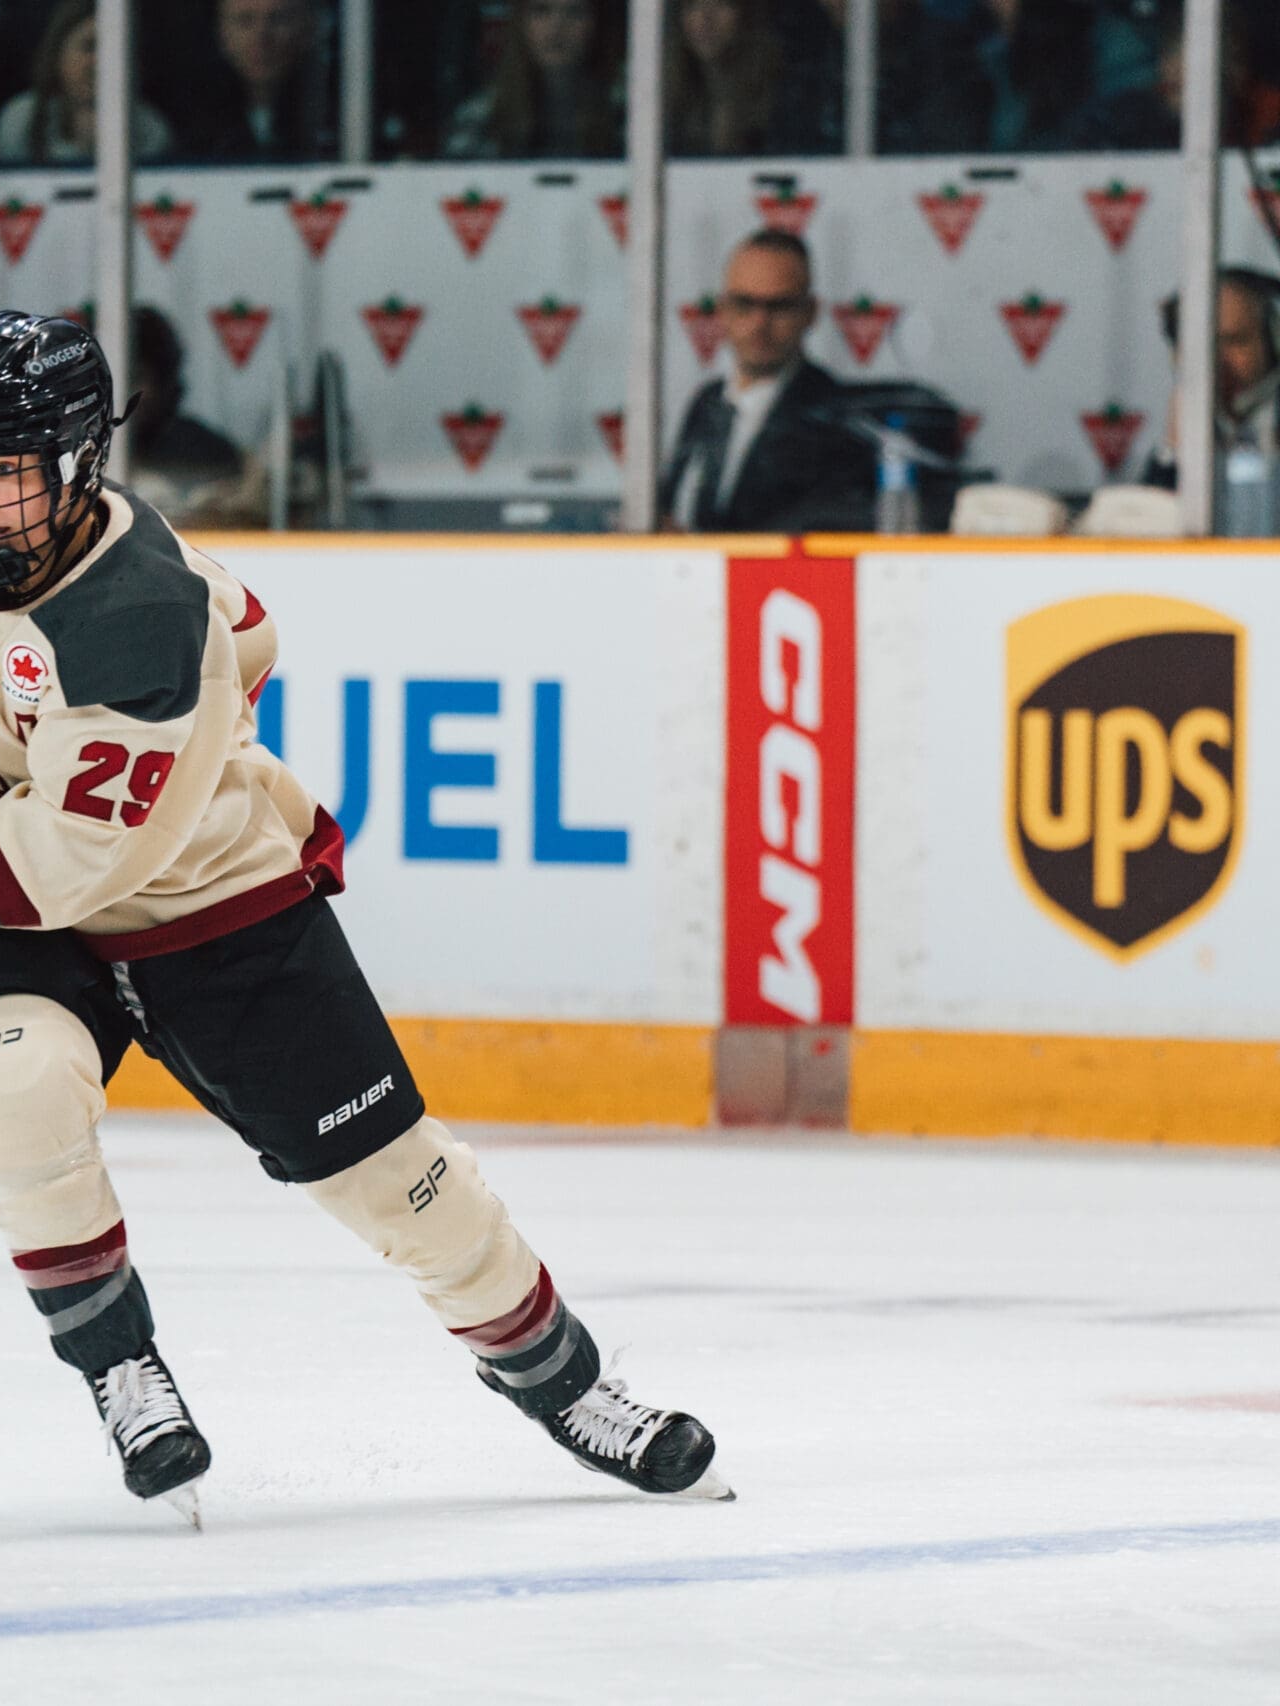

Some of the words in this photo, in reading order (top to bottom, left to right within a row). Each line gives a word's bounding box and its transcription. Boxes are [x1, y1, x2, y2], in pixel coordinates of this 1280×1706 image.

[42, 343, 88, 368] ROGERS
[62, 740, 176, 828] 29
[760, 588, 821, 1024] CCM
